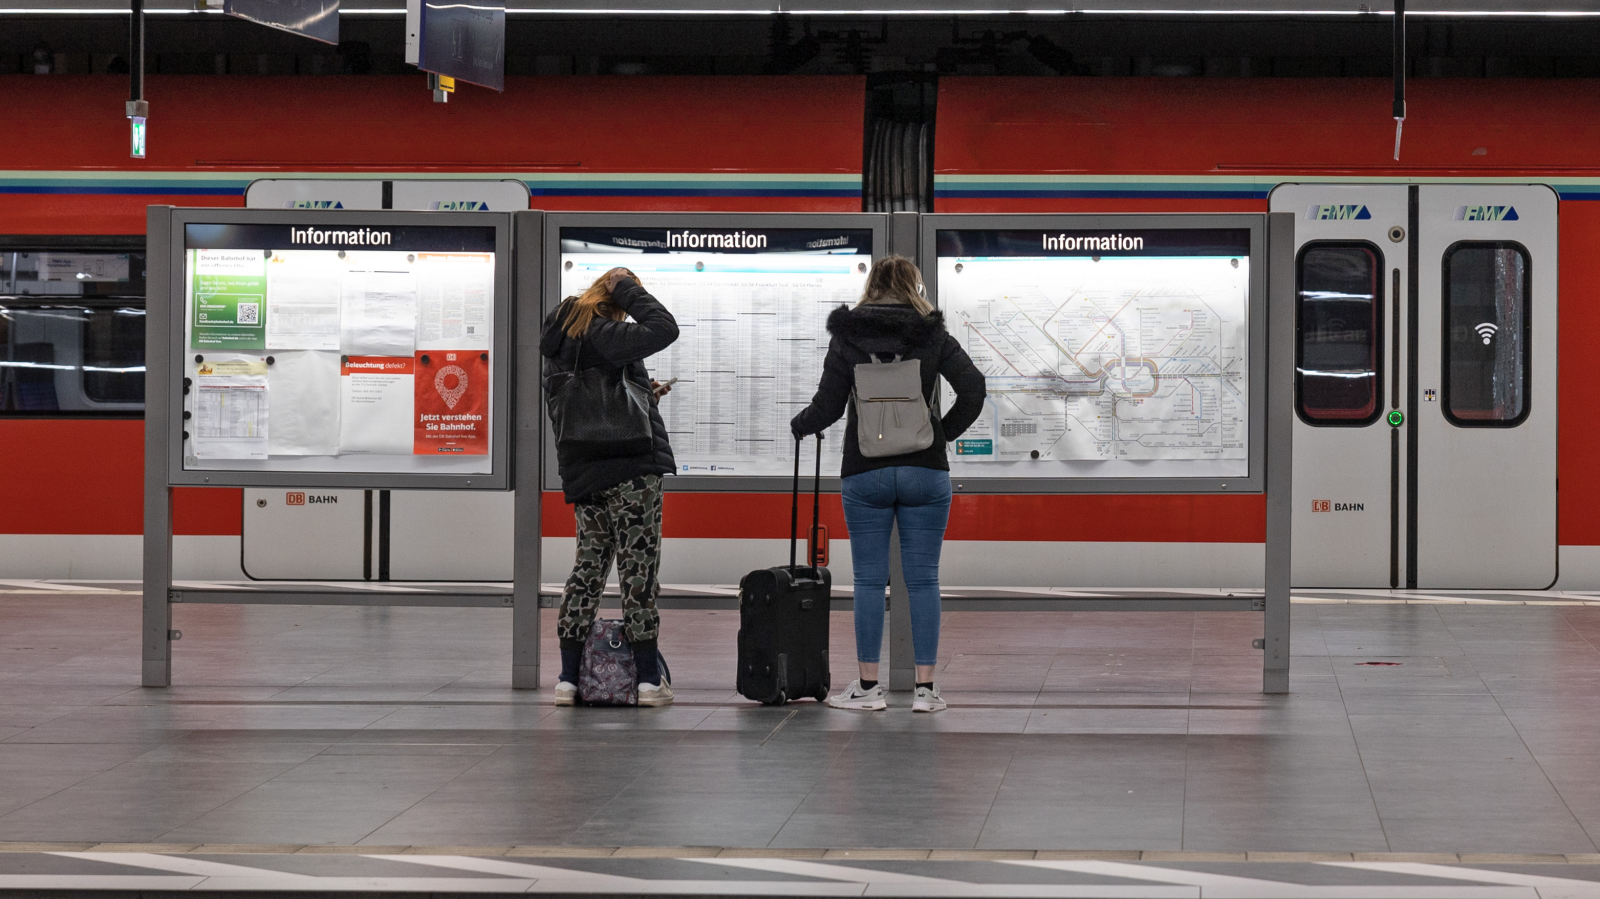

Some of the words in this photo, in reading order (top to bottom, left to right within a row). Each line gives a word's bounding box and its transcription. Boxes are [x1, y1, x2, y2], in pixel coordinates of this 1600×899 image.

[291, 227, 391, 245] Information
[666, 230, 767, 248] Information
[1043, 233, 1144, 250] Information
[345, 361, 385, 370] Beleuchtung
[420, 413, 440, 422] Jetzt
[441, 413, 482, 421] verstehen
[426, 423, 439, 431] Sie
[440, 422, 476, 431] Bahnhof.
[287, 493, 304, 504] DB
[309, 496, 337, 504] BAHN
[1313, 501, 1329, 511] DB
[1334, 503, 1364, 512] BAHN
